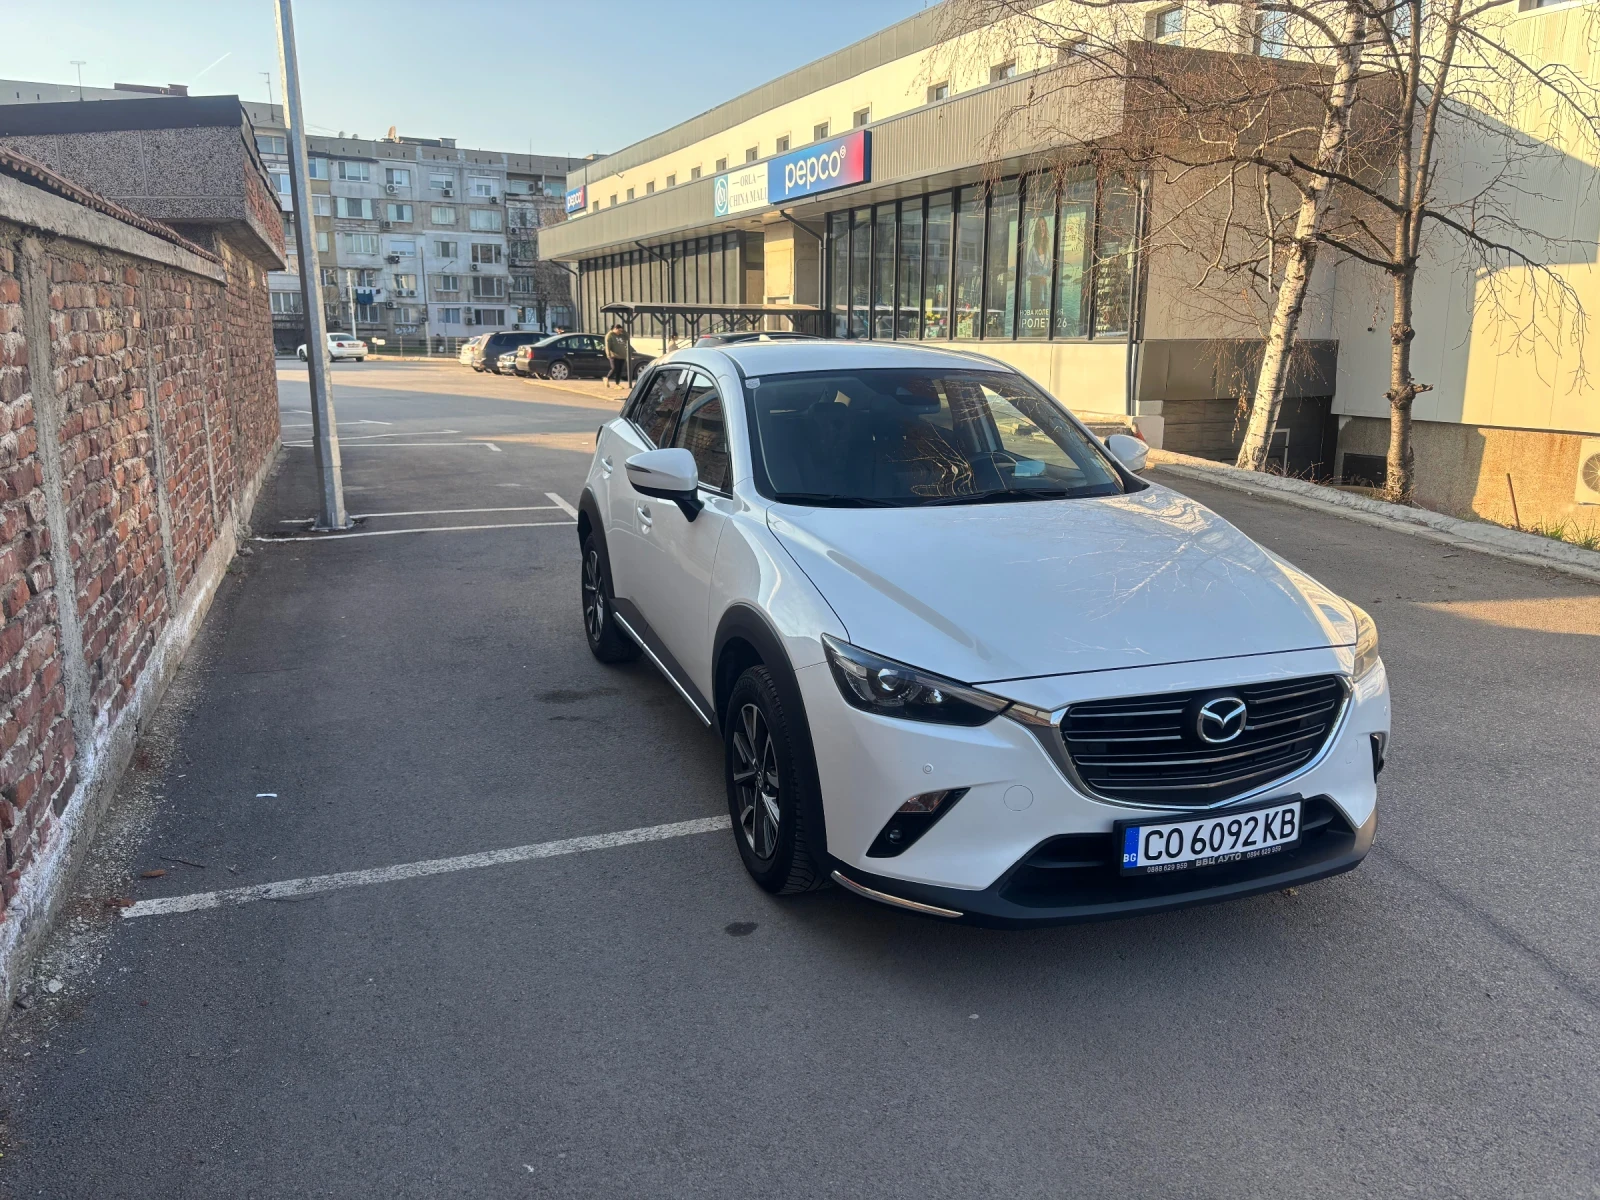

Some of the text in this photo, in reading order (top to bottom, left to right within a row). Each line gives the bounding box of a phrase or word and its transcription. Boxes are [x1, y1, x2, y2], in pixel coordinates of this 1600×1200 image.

[740, 173, 757, 187] ORLA
[729, 191, 749, 208] CHINA
[1123, 852, 1137, 863] BG
